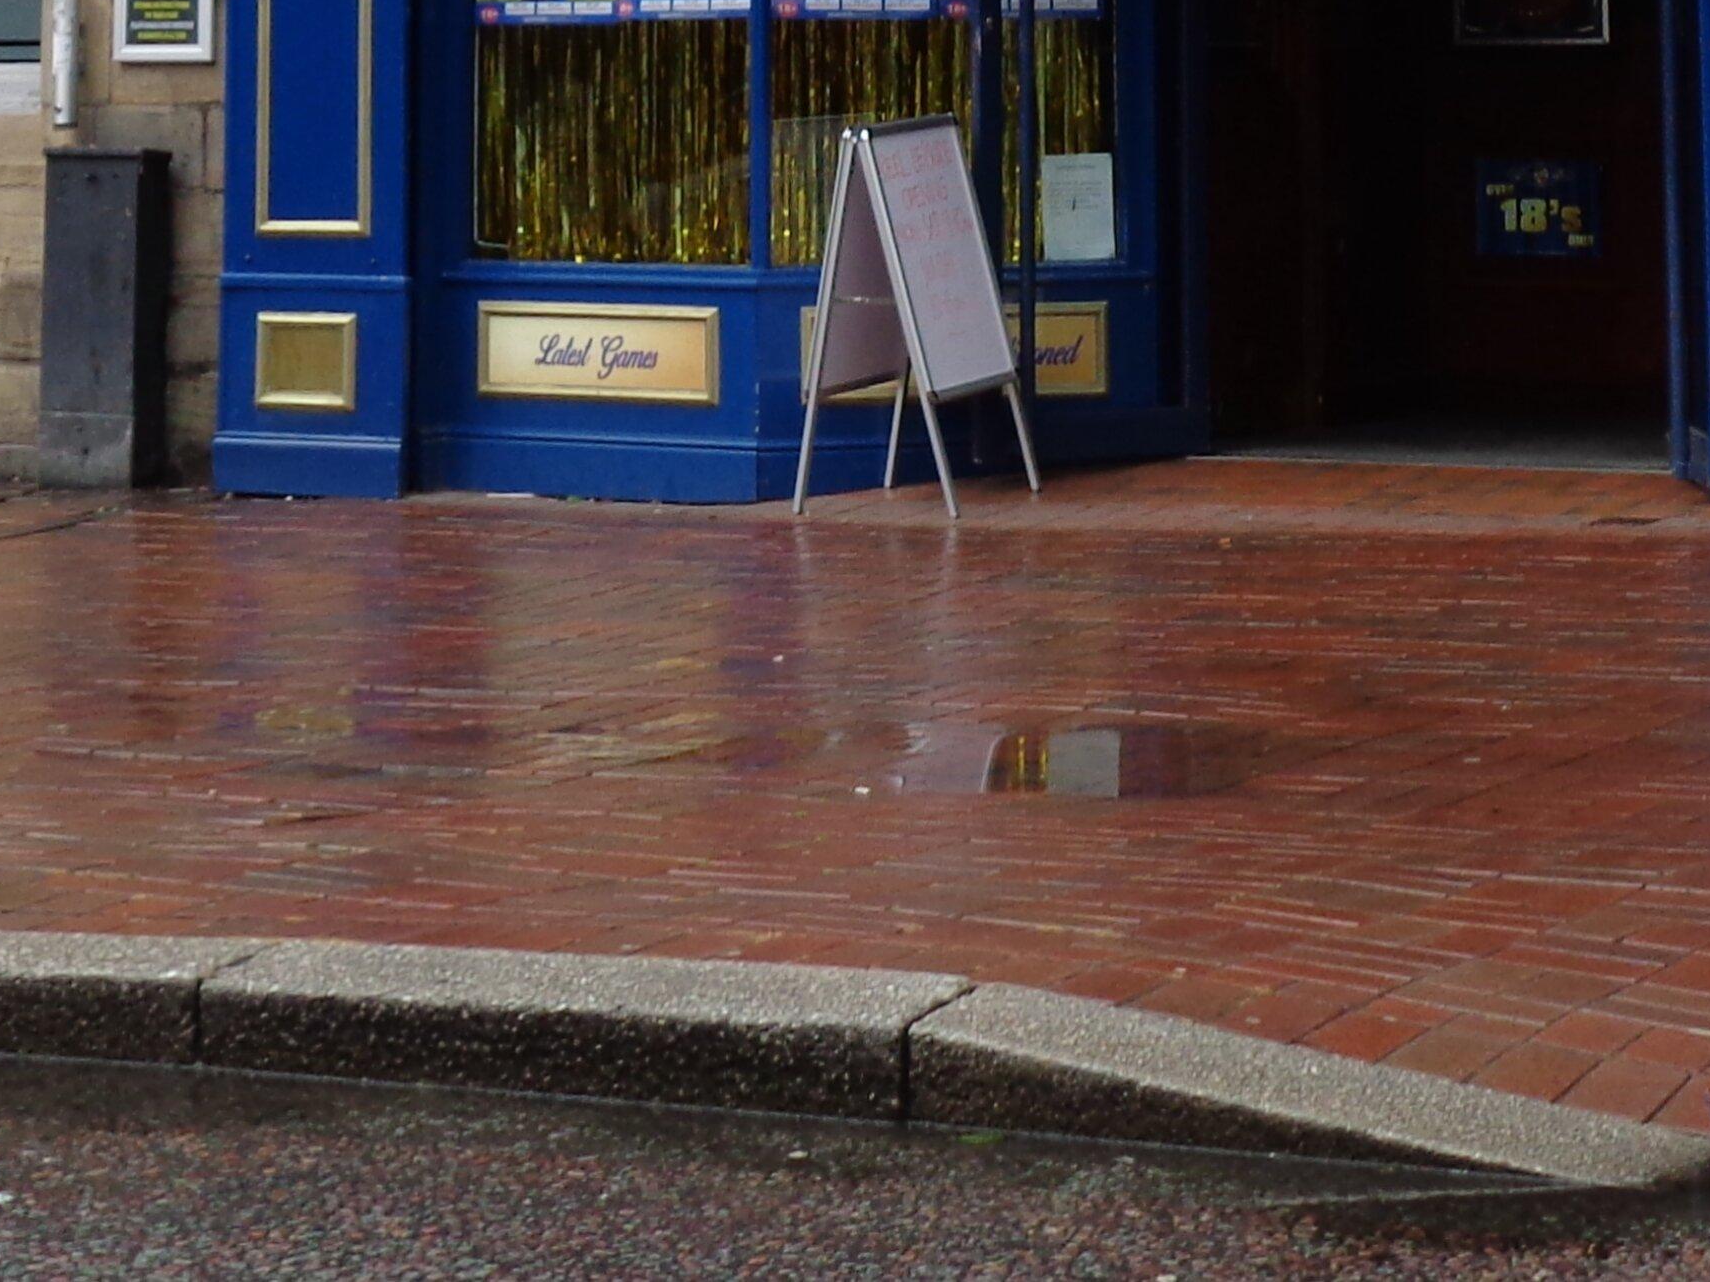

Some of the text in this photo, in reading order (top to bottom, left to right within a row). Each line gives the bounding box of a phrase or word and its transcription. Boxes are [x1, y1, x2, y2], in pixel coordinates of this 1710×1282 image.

[1499, 197, 1585, 234] 18's
[534, 333, 659, 380] Latest Games
